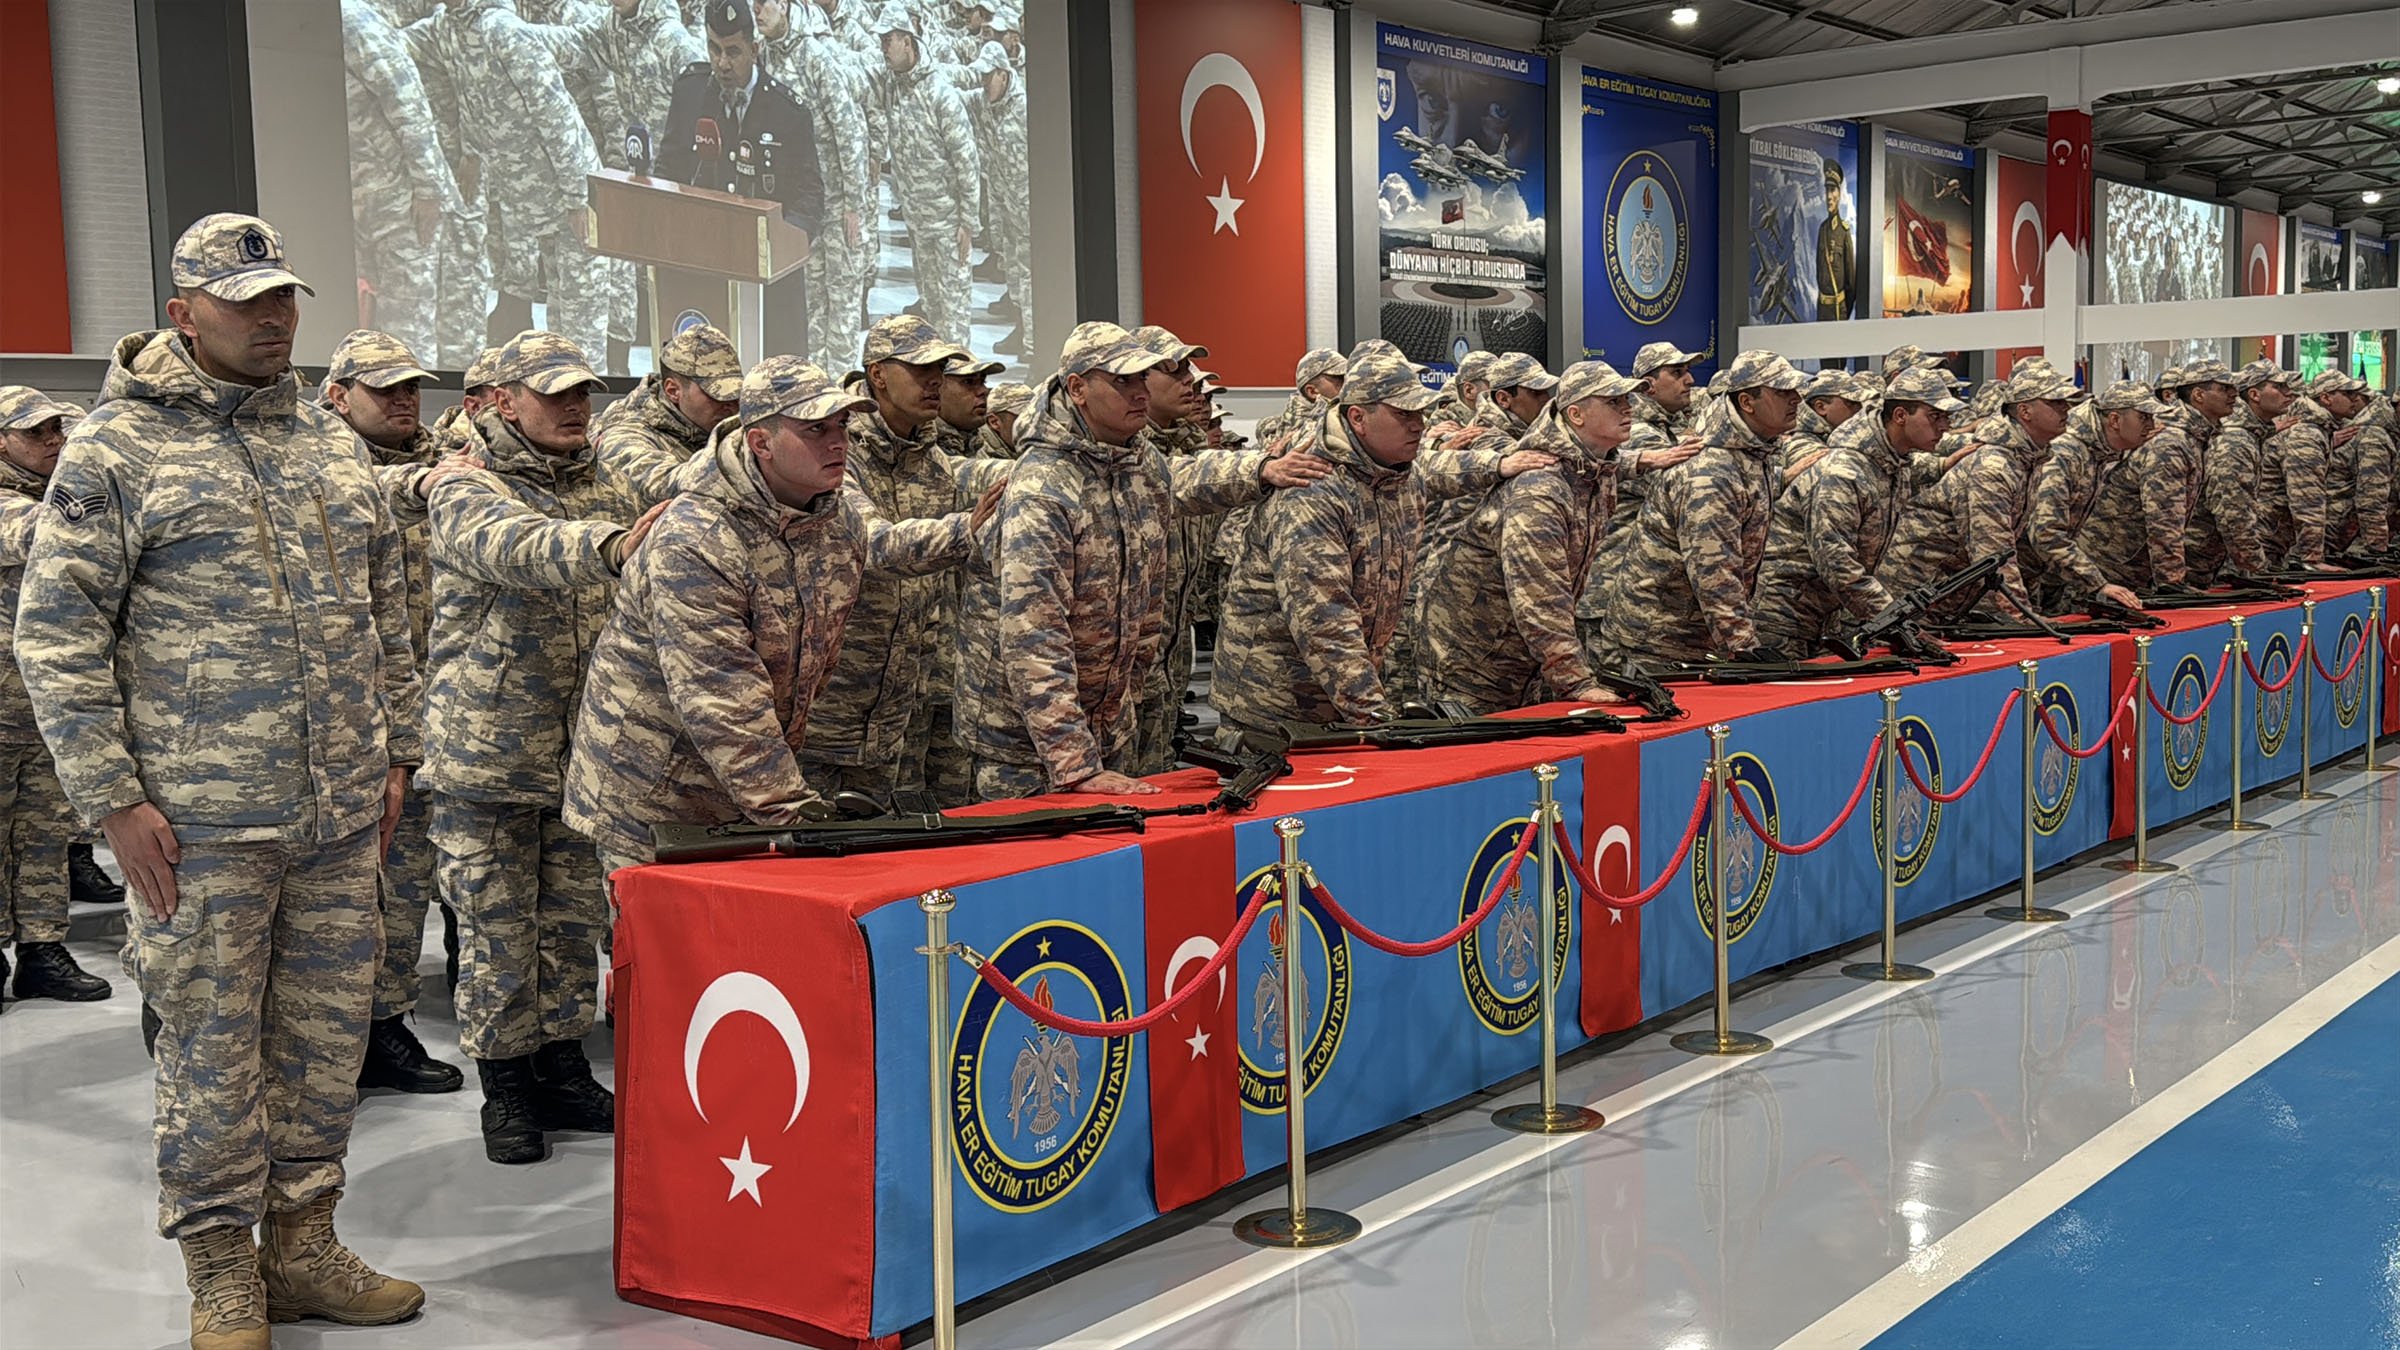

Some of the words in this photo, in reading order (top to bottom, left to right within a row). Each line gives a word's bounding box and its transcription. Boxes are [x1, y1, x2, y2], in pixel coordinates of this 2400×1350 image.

[1384, 32, 1411, 49] HAVA
[1412, 38, 1470, 62] KUVVETLERİ
[1471, 51, 1529, 74] KOMUTANLIĞI
[1599, 78, 1610, 90] ER
[1635, 85, 1658, 99] TUGAY
[695, 134, 715, 145] DHA
[1431, 231, 1452, 250] TÜRK
[1453, 235, 1489, 256] ORDUSU;
[1607, 214, 1615, 254] HAVA
[1389, 250, 1438, 273] DÜNYANIN
[1439, 254, 1471, 278] HİÇBİR
[1472, 260, 1526, 280] ORDUSUNDA
[1610, 255, 1619, 274] ER
[1663, 222, 1686, 307] KOMUTANLIĞI
[1616, 276, 1639, 313] EĞİTİM
[1639, 301, 1663, 317] TUGAY
[1875, 787, 1883, 827] HAVA
[1917, 774, 1939, 863] KOMUTANIĞI
[1697, 837, 1706, 881] HAVA
[1750, 815, 1776, 917] KOMUTANIĞI
[1698, 881, 1707, 904] ER
[1467, 963, 1480, 991] ER
[1475, 989, 1507, 1026] EĞİTİM
[1507, 995, 1539, 1025] TUGAY
[1552, 886, 1569, 983] MUTANLIĞI
[1513, 980, 1527, 993] 1956
[1238, 1064, 1267, 1104] ĞİTİM
[1309, 943, 1346, 1077] KOMUTANLIĞI
[1274, 1053, 1286, 1065] 19
[956, 1054, 973, 1124] HAVA
[1076, 1005, 1124, 1164] KOMUTANLĞI
[960, 1120, 981, 1159] ER
[1034, 1135, 1057, 1153] 1956
[973, 1150, 1023, 1200] EĞİTİM
[1026, 1154, 1076, 1199] TUGAY
